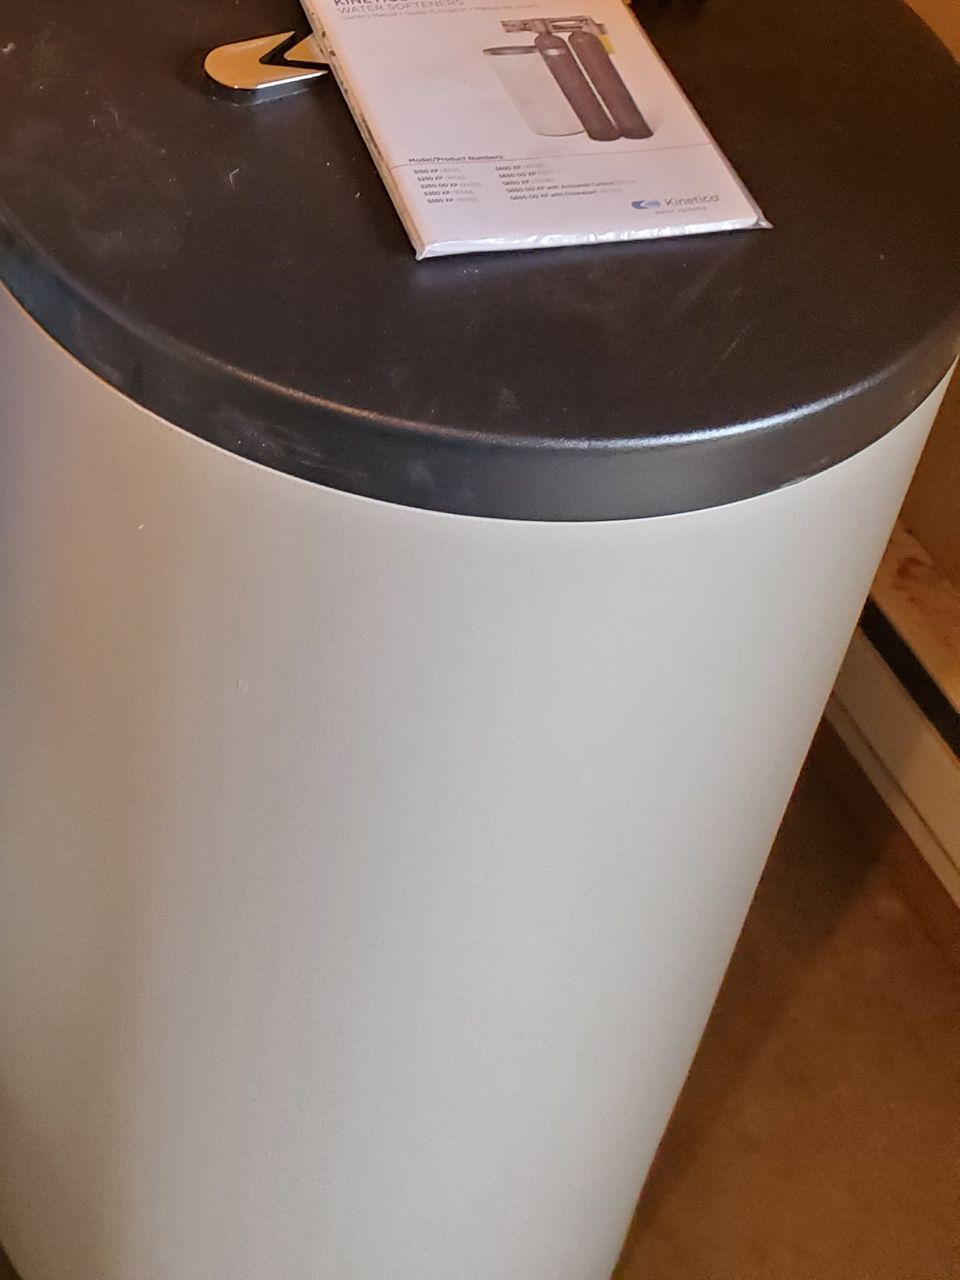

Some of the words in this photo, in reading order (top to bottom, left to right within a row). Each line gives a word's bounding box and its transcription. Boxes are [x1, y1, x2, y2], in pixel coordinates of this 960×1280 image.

[338, 4, 383, 14] WATER
[386, 0, 464, 10] SOFTENERS
[664, 194, 719, 206] Kinetico
